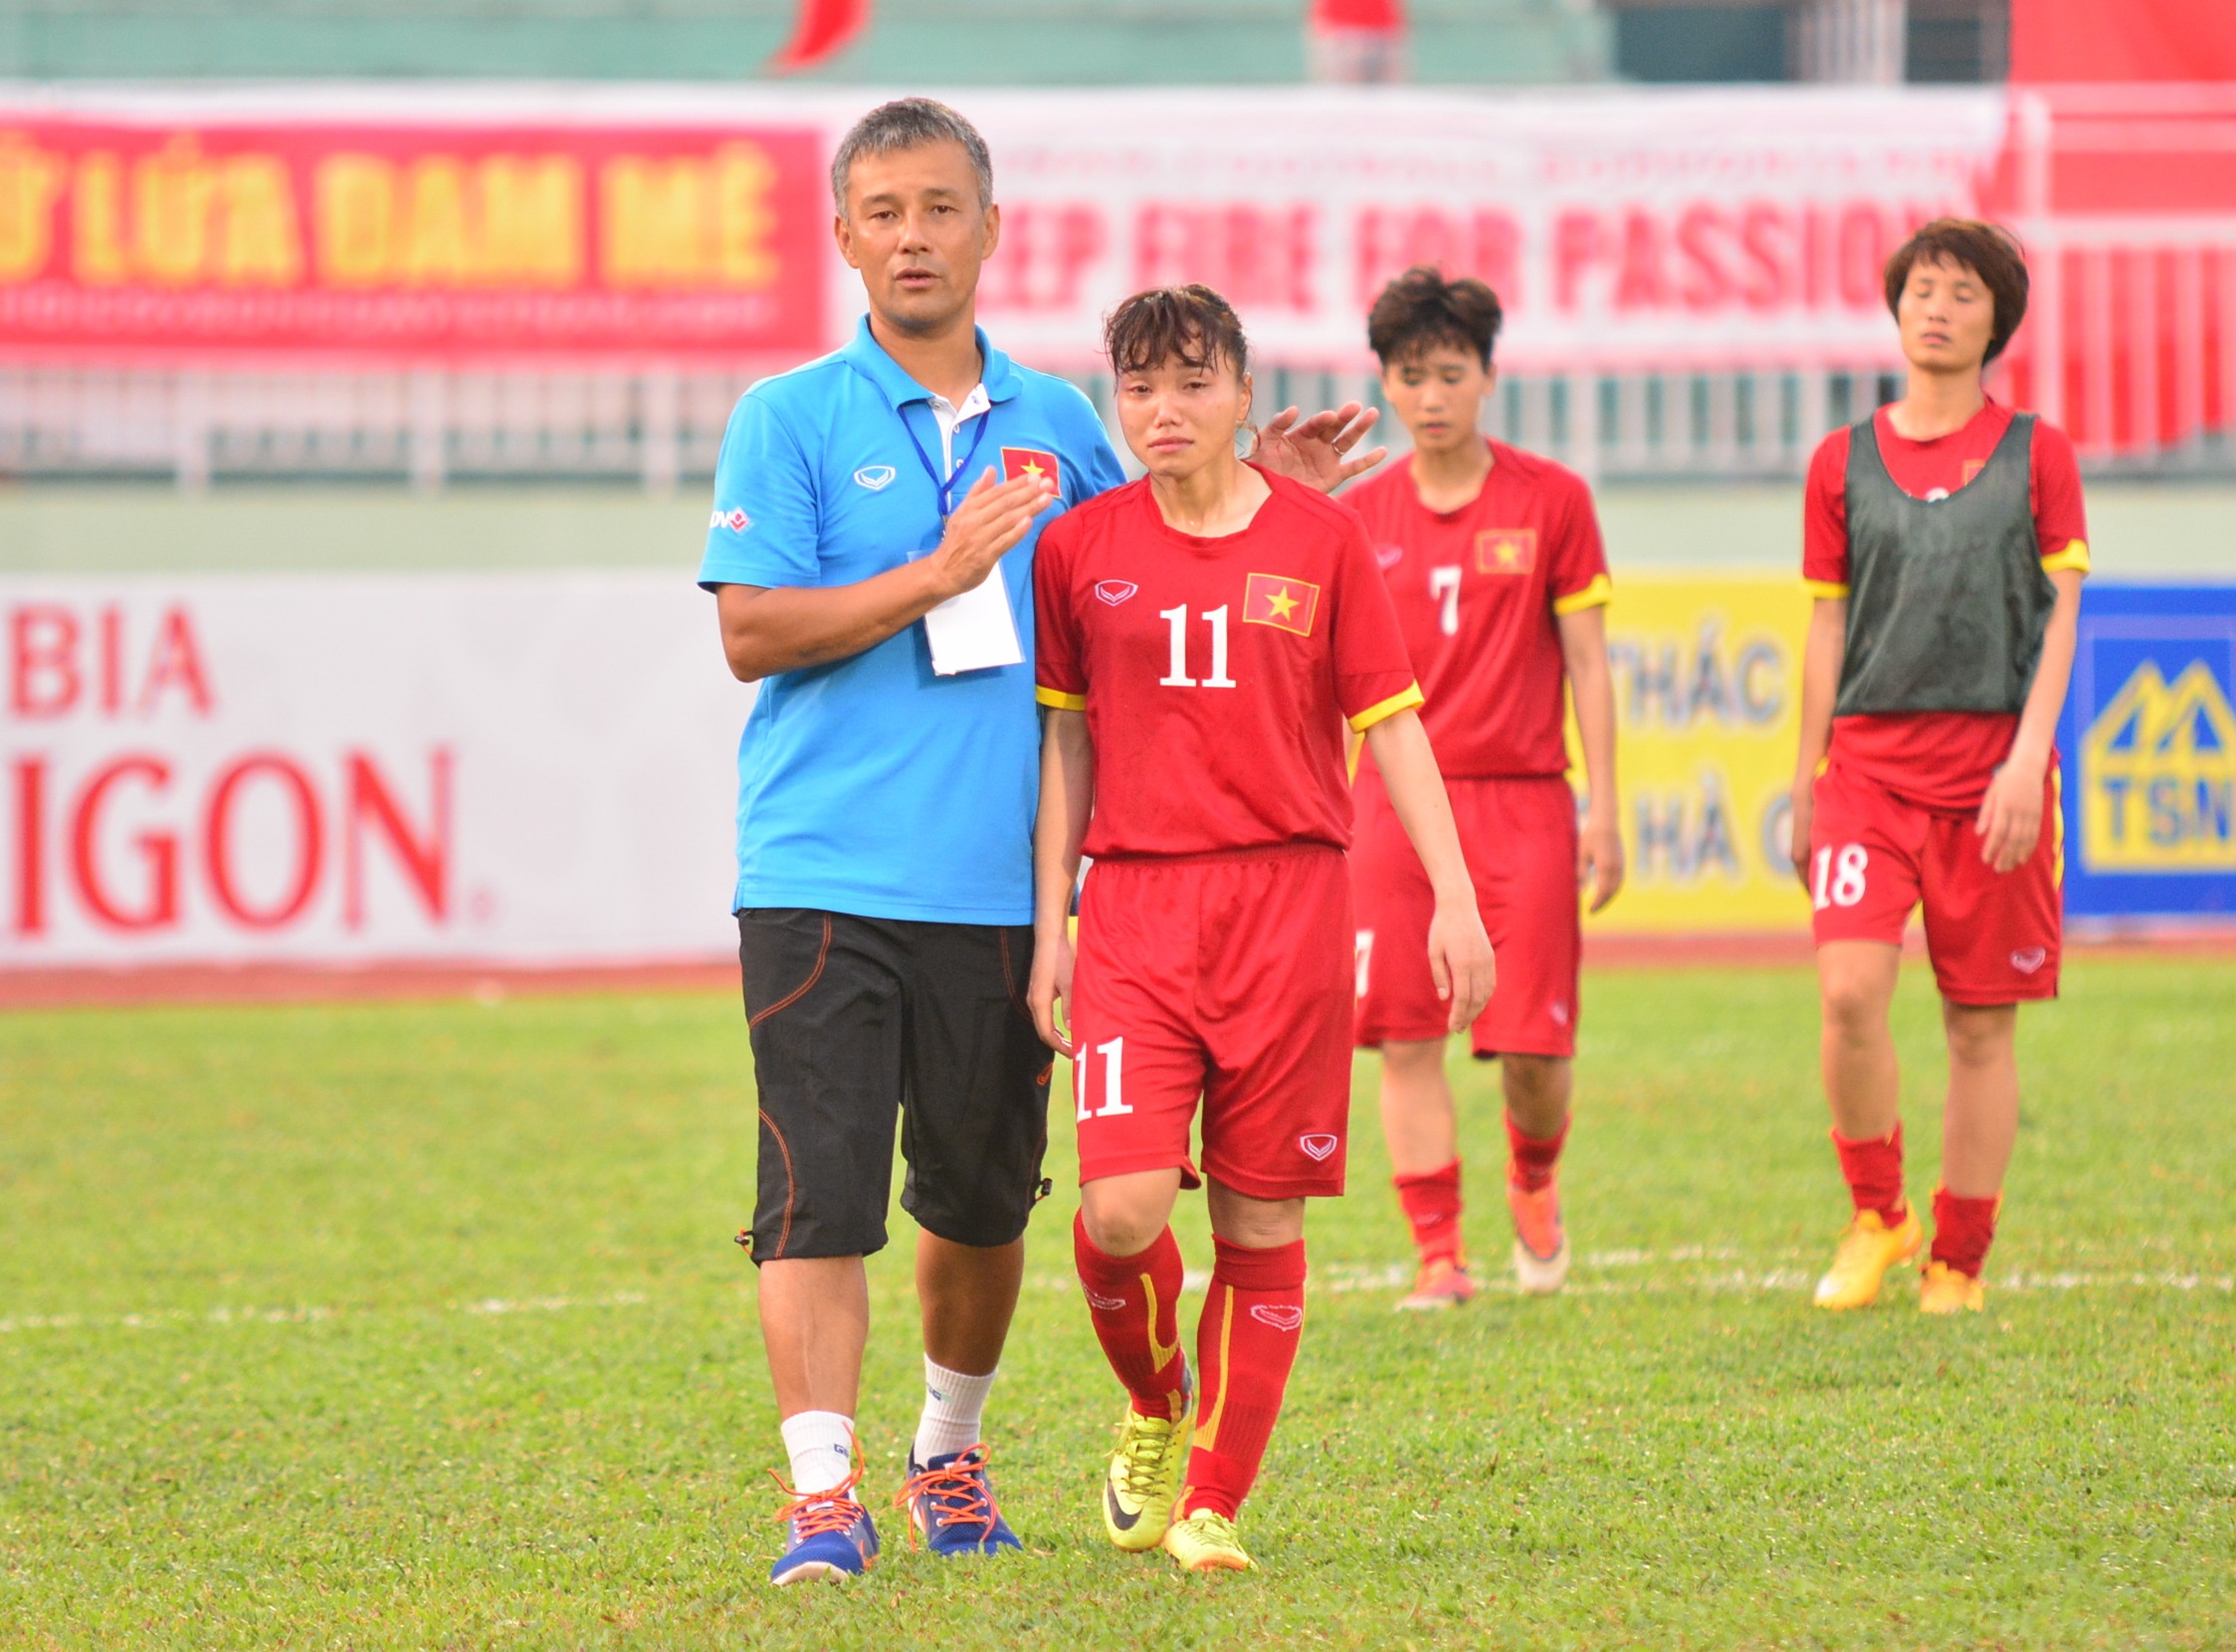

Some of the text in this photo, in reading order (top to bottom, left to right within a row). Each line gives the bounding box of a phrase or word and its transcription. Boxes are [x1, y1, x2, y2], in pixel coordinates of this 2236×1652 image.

[1132, 202, 1314, 316] FIRE
[1355, 203, 1520, 311] FOR
[1551, 200, 1958, 315] PASSIO
[1430, 565, 1462, 636] 7
[8, 603, 213, 720] BIA
[1159, 604, 1236, 688] 11
[8, 743, 458, 935] IGON
[2101, 775, 2234, 844] TSN
[1814, 842, 1869, 911] 18
[1076, 1037, 1132, 1123] 11
